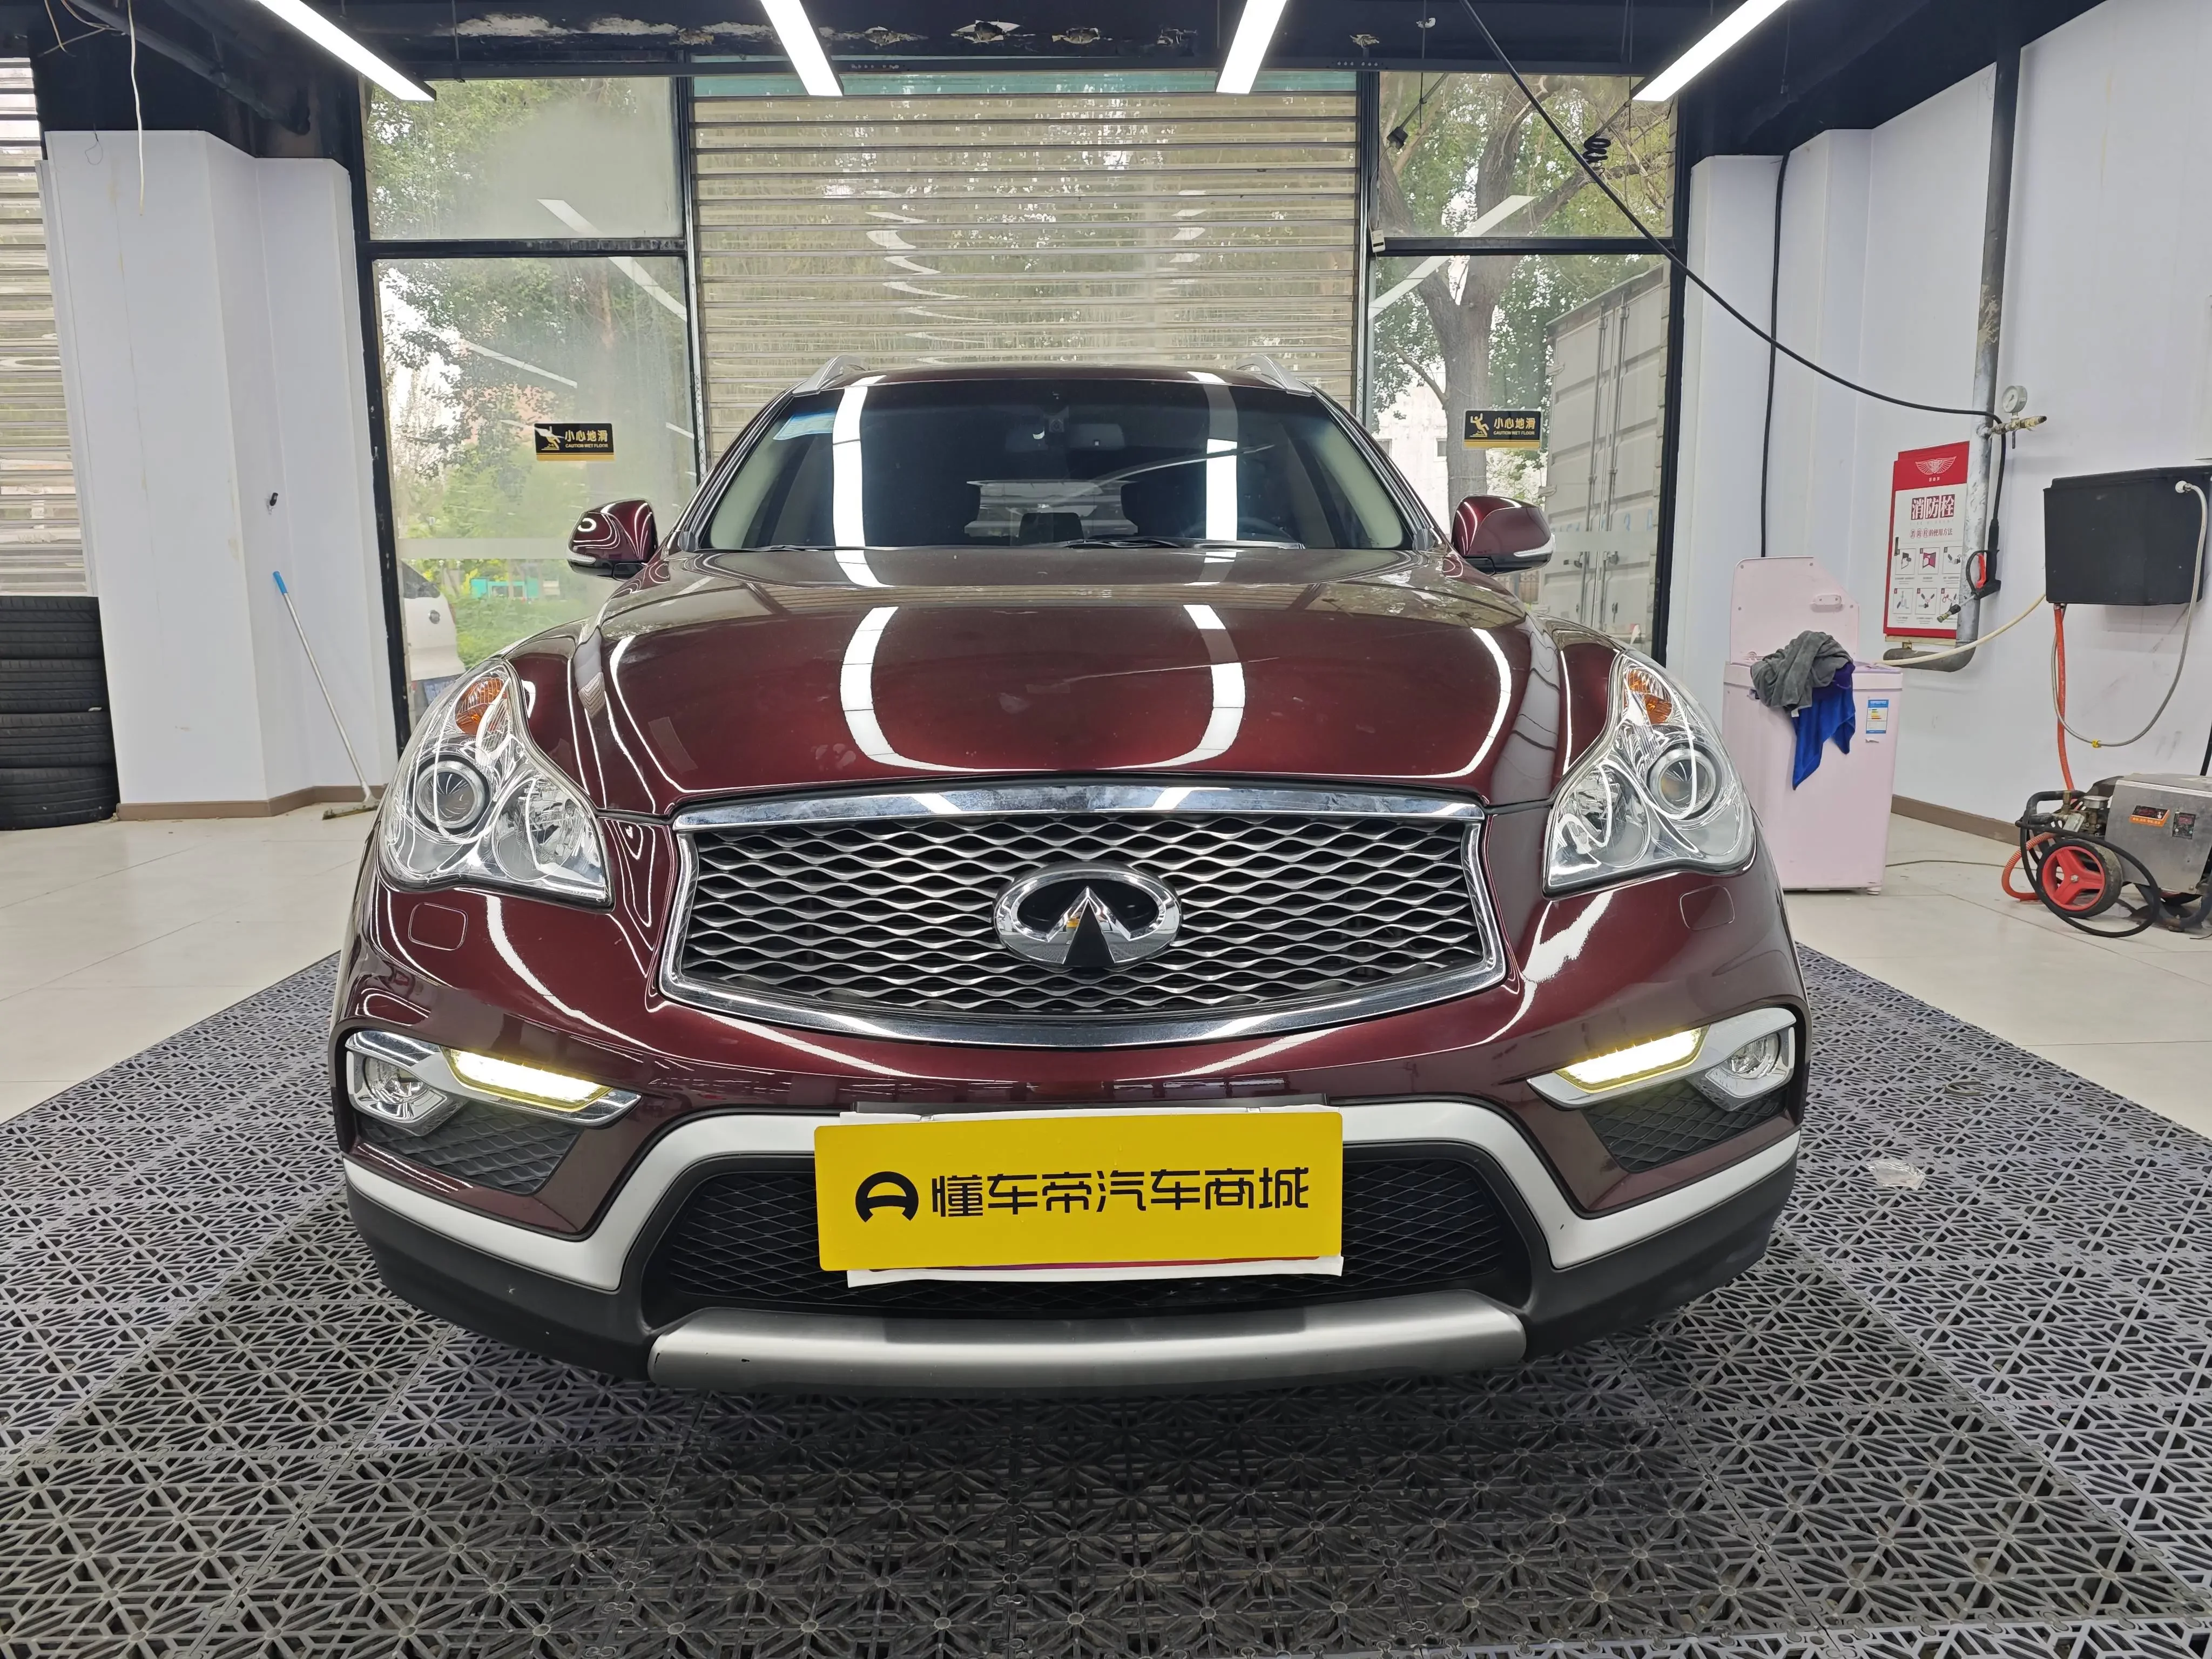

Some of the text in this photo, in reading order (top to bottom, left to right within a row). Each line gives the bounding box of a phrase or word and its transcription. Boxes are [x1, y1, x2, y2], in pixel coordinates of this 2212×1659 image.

[1494, 417, 1535, 429] 小心地滑
[565, 430, 608, 442] 小心地滑
[1911, 495, 1955, 520] 消防栓
[932, 1166, 1310, 1218] 懂车帝汽车商城
